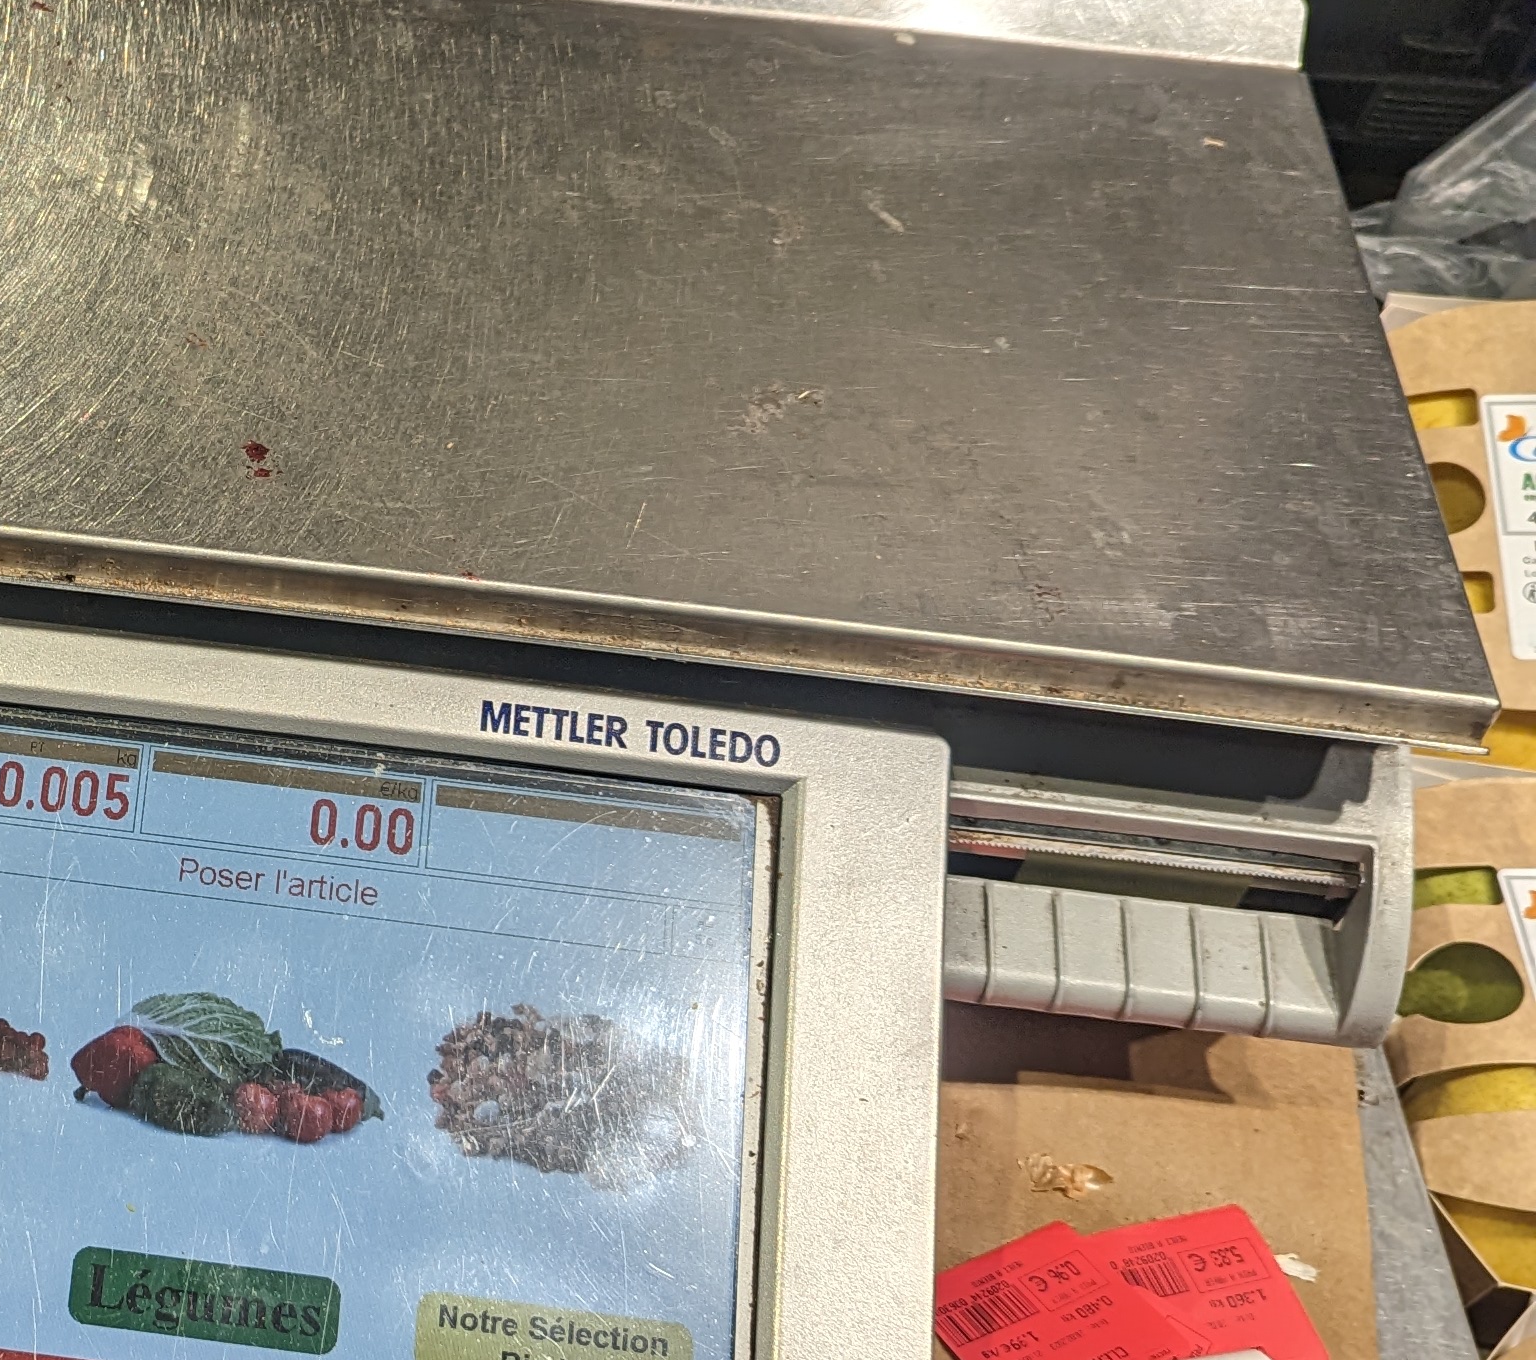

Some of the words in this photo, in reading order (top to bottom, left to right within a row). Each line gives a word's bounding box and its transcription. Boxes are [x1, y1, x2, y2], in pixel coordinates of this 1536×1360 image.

[116, 749, 138, 769] kg
[478, 699, 630, 749] METTLER
[642, 719, 782, 768] TOLEDO
[307, 795, 417, 858] 0.00
[176, 854, 266, 895] Poser
[273, 866, 380, 909] l'article
[85, 1261, 326, 1347] Légumes
[437, 1305, 519, 1336] Notre
[527, 1314, 670, 1358] Sélection
